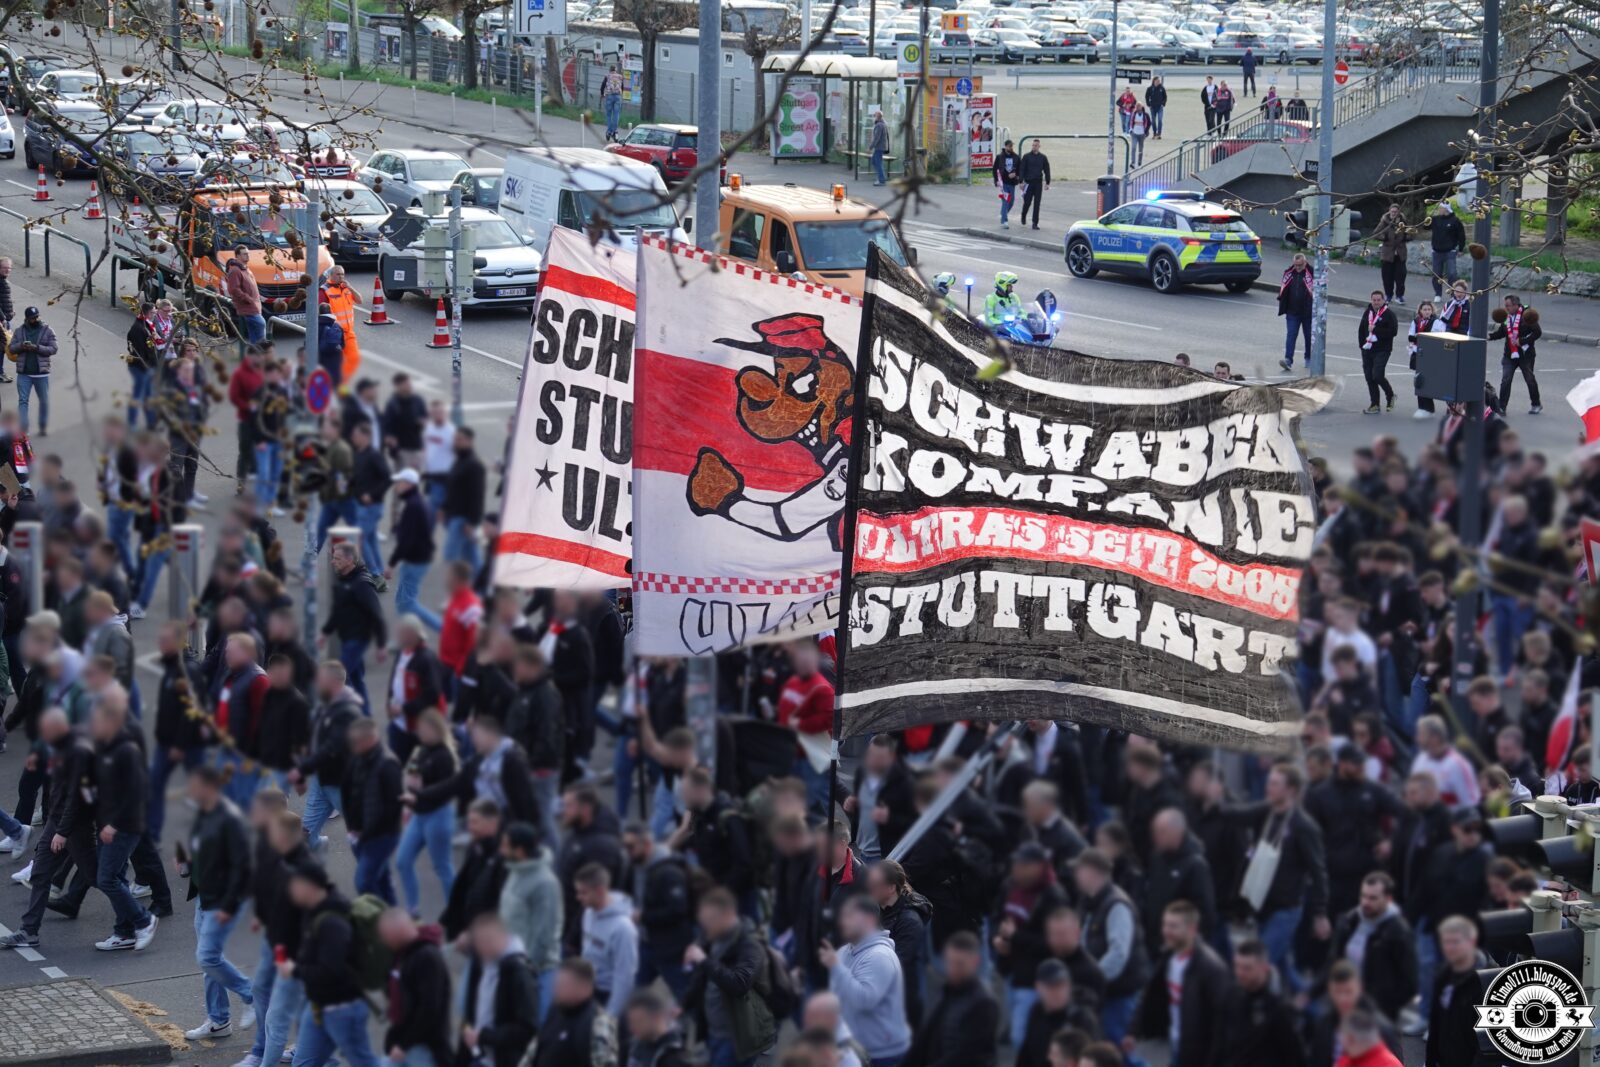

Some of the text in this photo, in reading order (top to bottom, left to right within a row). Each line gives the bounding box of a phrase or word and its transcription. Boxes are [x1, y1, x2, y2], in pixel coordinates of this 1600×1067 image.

[779, 122, 819, 132] Street Art
[780, 99, 817, 109] Stuttgart
[504, 177, 518, 199] SK
[1097, 236, 1122, 247] POLIZEI
[532, 298, 635, 384] SCH
[868, 336, 1305, 487] SCHWABEN
[562, 463, 634, 541] UL
[863, 420, 1314, 560] KOMPANIE
[857, 511, 1047, 564] ULTRAS
[1055, 526, 1180, 580] SEIT
[849, 571, 1299, 677] STUTTGART
